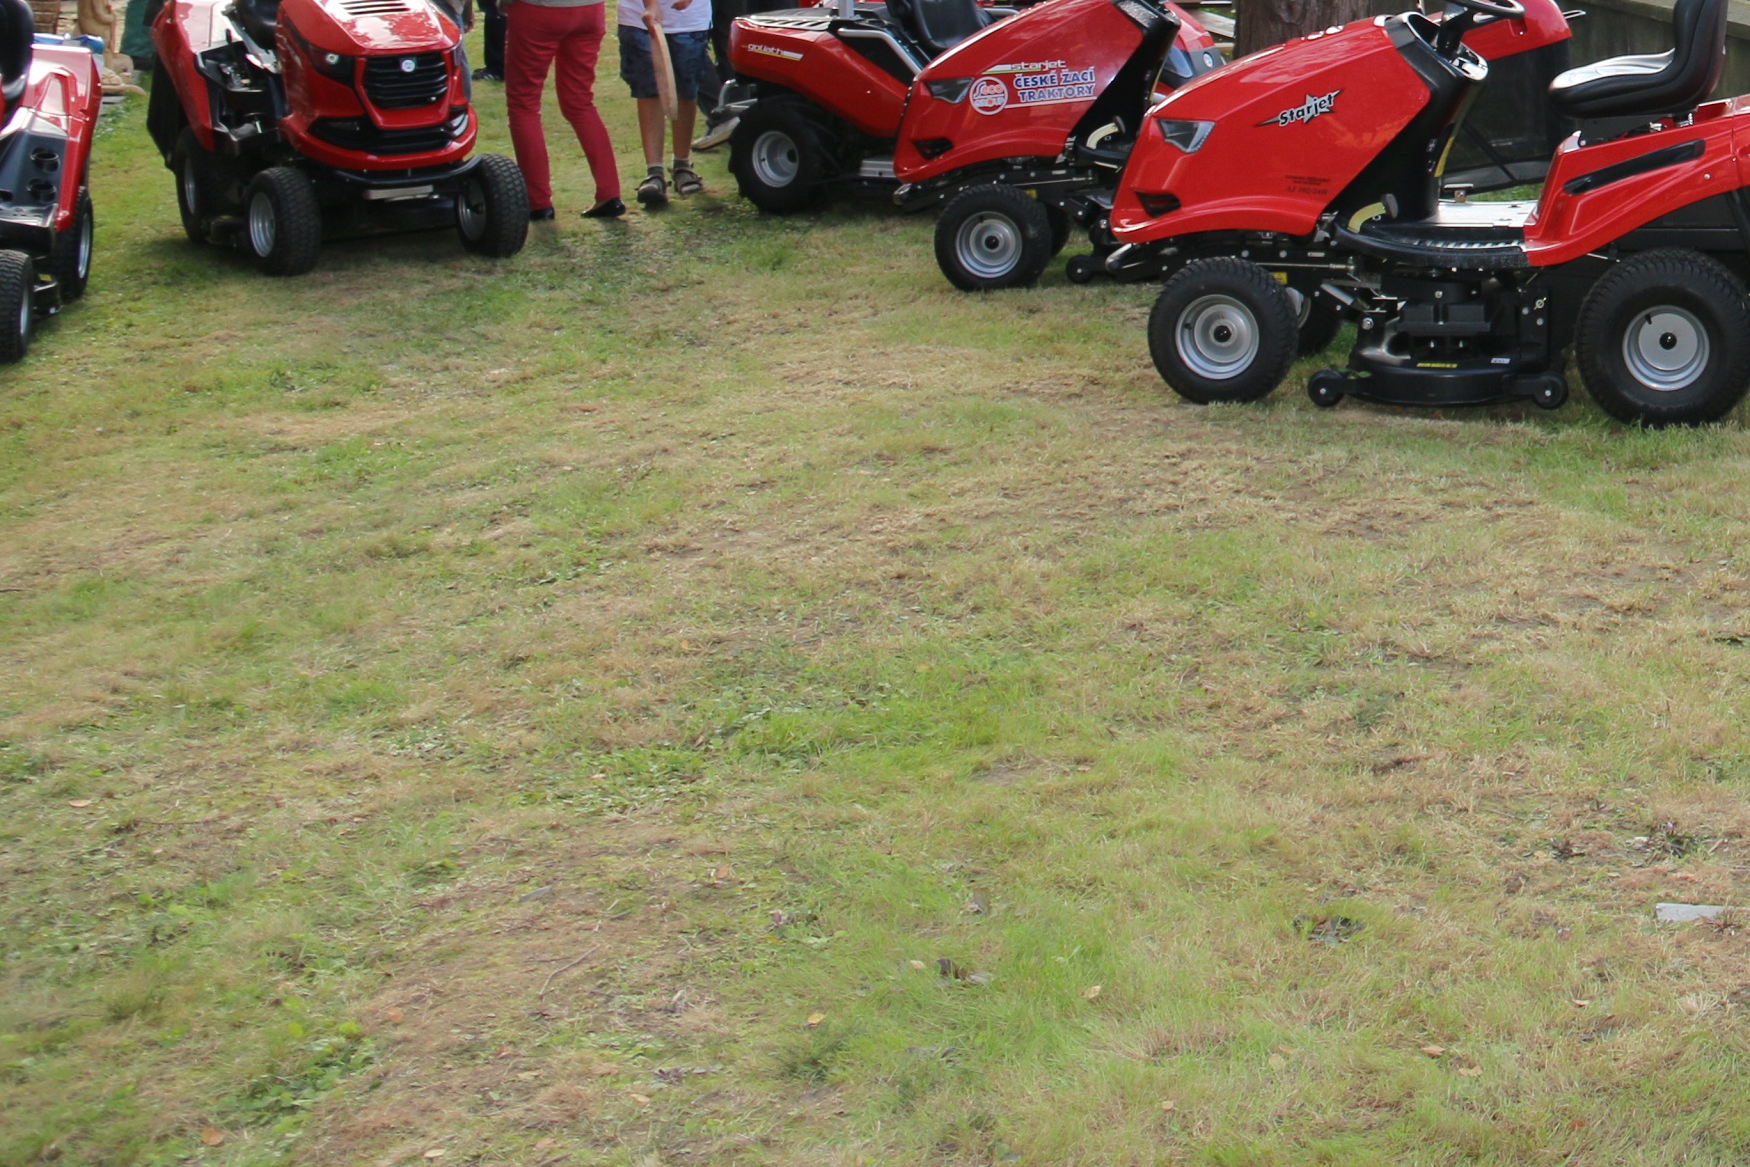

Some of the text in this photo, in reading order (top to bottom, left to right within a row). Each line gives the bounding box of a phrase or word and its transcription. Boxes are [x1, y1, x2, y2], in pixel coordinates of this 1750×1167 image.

[1011, 60, 1066, 72] starjet
[1014, 66, 1095, 88] ČESKÉ ŽACÍ
[1018, 84, 1095, 103] TRAKTORY
[1278, 93, 1335, 127] Starjet
